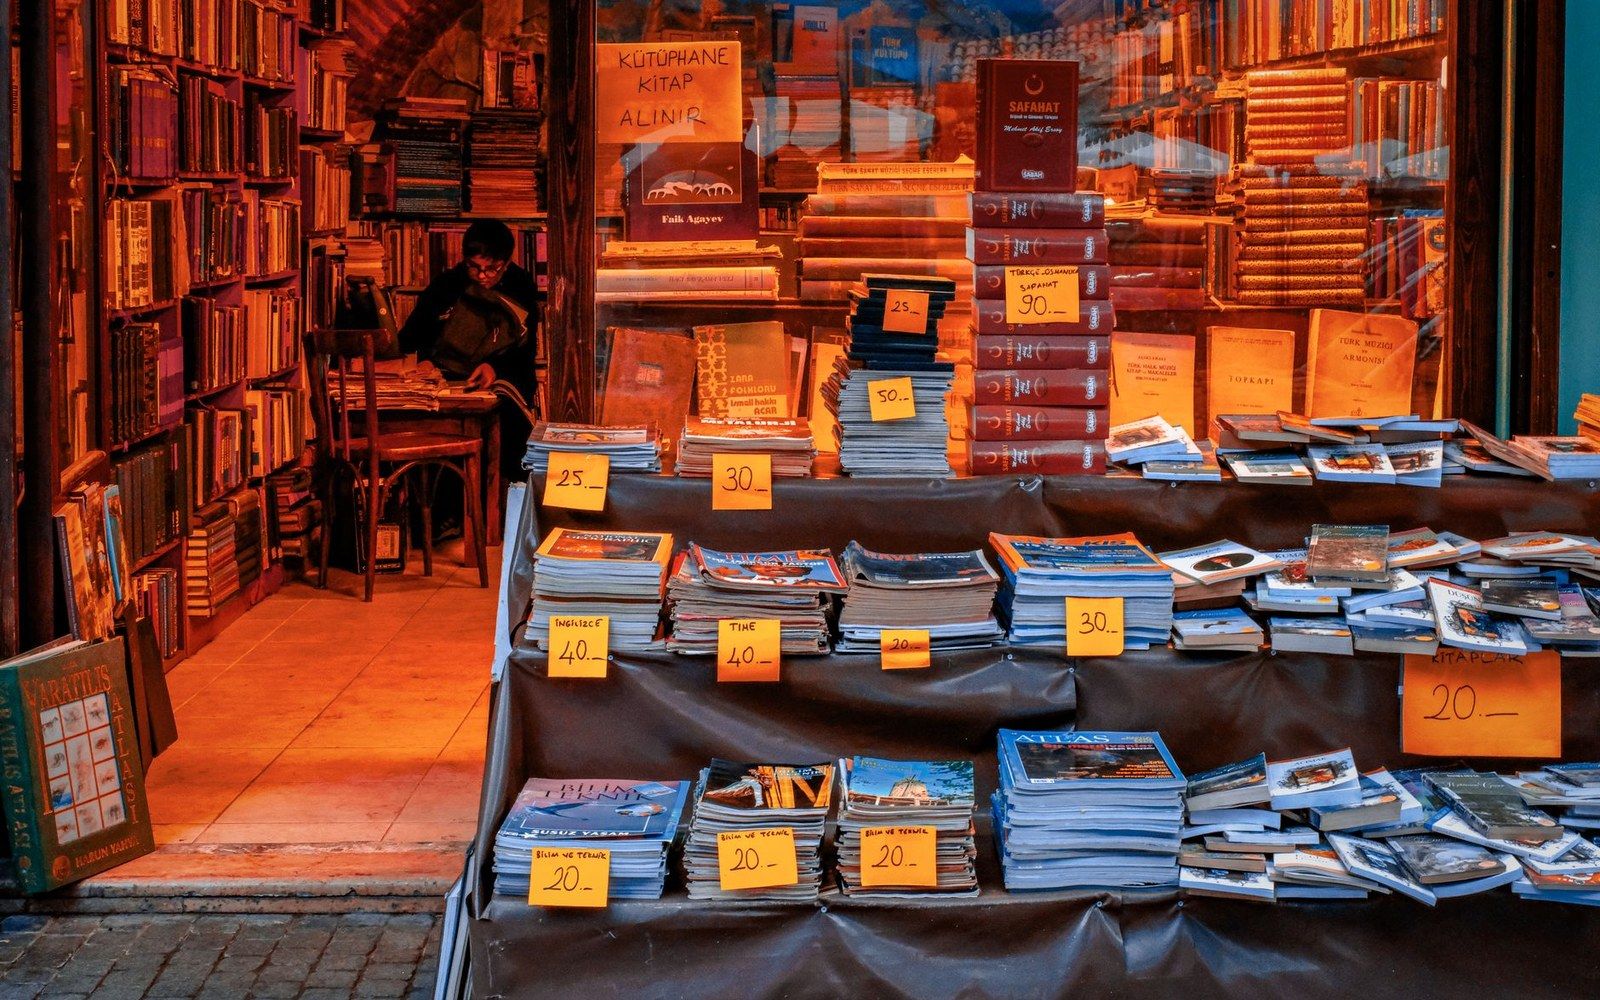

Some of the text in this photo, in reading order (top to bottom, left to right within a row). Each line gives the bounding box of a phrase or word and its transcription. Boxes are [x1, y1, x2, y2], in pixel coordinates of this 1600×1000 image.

[618, 47, 729, 68] KÜTÜPHANE
[638, 73, 693, 93] KİTAP
[620, 106, 706, 127] ALINIR
[1009, 102, 1061, 113] SAFAHAT
[662, 215, 724, 224] Faik Agayev
[1083, 199, 1091, 222] SABAH
[1084, 236, 1094, 259] SABAH
[1086, 271, 1096, 294] SABAH
[1089, 306, 1099, 329] SABAH
[1087, 340, 1097, 364] SABAH
[1085, 376, 1095, 399] SABAH
[1086, 409, 1096, 433] SABAH
[1083, 445, 1092, 468] SABAH
[729, 621, 758, 632] TIME
[1015, 733, 1110, 744] ATLAS
[562, 851, 574, 859] VE
